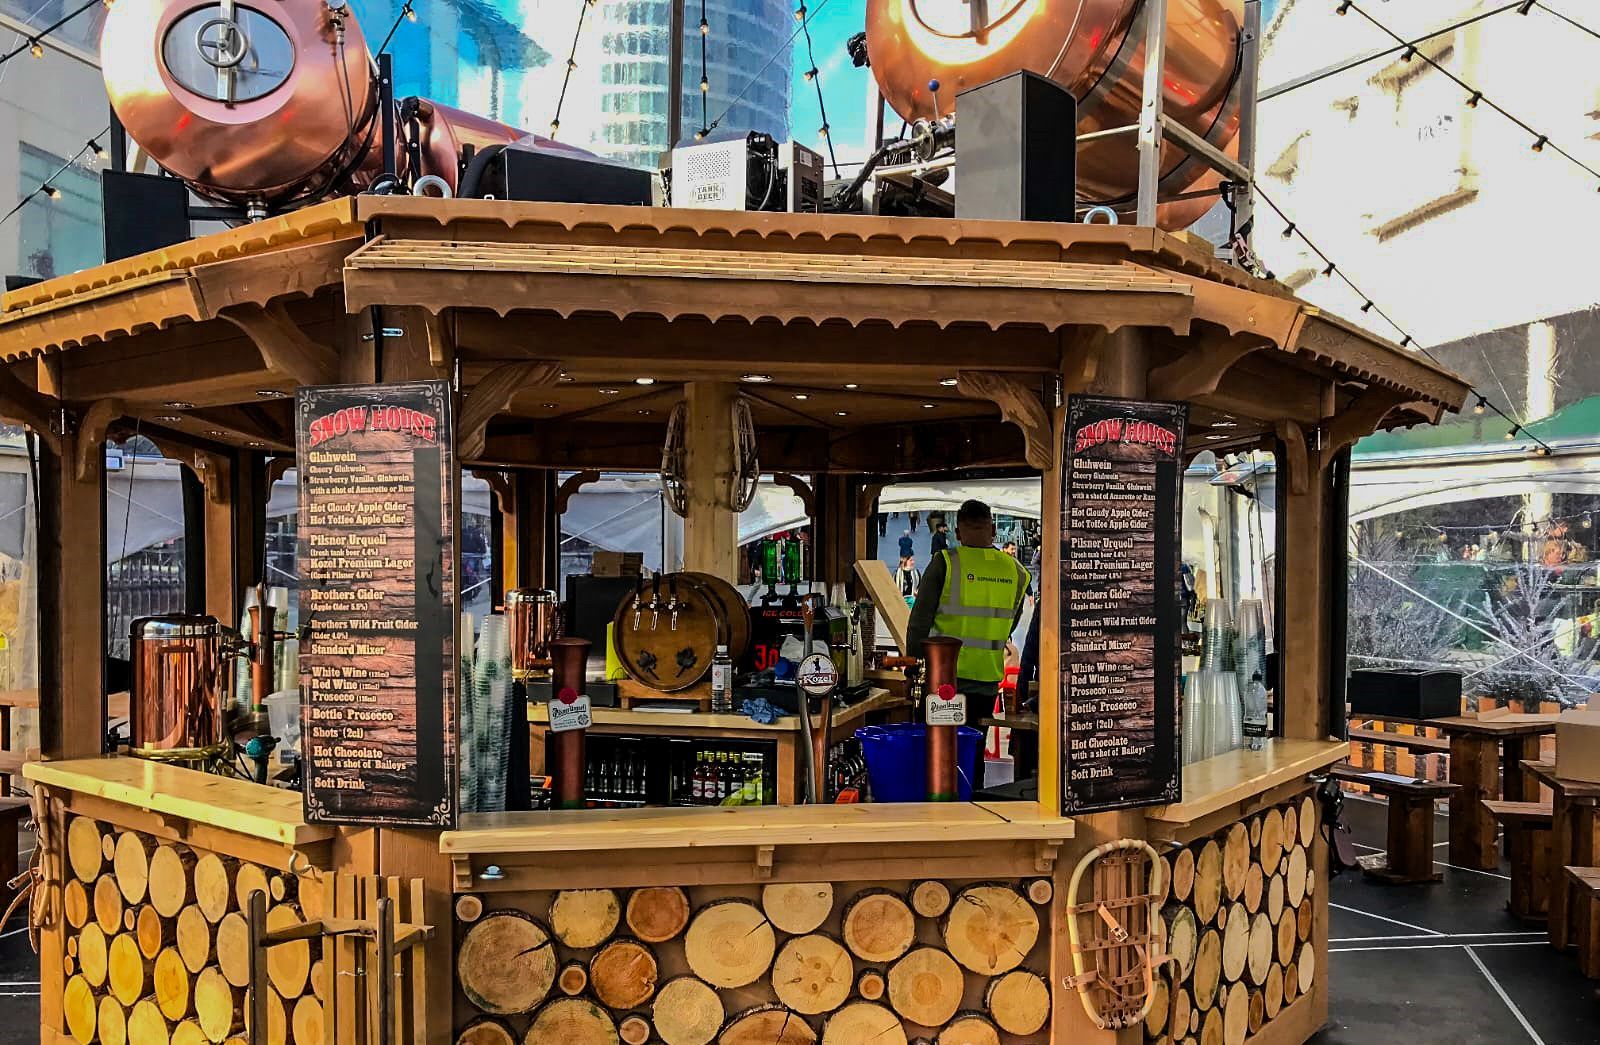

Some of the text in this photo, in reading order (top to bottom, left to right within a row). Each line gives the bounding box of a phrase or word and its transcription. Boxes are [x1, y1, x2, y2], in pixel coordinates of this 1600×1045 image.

[310, 404, 436, 447] SNOW HOUSE
[1075, 418, 1176, 457] SNOW HOUSE
[309, 452, 356, 463] Gluhwein
[310, 476, 349, 484] Strawberry
[310, 487, 325, 495] with
[310, 502, 407, 514] Hot Cloudy Apple Cider
[1071, 508, 1149, 518] Hot Cloudy Apple Cider
[310, 514, 406, 525] Hot Toffee Apple Cider
[1072, 519, 1148, 530] Hot Toffee Apple Cider
[310, 534, 386, 547] Pilsner Urquell
[1071, 537, 1133, 550] Pilsner Urquell
[310, 558, 413, 570] Kozel Premium Lager
[1071, 560, 1153, 571] Kozel Premium Lager
[311, 589, 385, 600] Brothers Cider
[1071, 589, 1131, 600] Brothers Cider
[311, 620, 419, 629] Brothers Wild Fruit Cider
[1071, 616, 1157, 627] Brothers Wild Fruit Cider
[311, 644, 385, 655] Standard Mixer
[1071, 640, 1131, 652] Standard Mixer
[312, 667, 340, 678] White
[342, 666, 367, 678] Wine
[1071, 663, 1094, 674] White
[1097, 662, 1117, 673] Wine
[312, 679, 331, 690] Red
[333, 678, 358, 689] Wine
[804, 674, 832, 684] Kozel
[1071, 675, 1087, 685] Red
[1089, 675, 1109, 684] Wine
[312, 691, 354, 702] Prosecco
[1071, 686, 1106, 697] Prosecco
[1071, 701, 1137, 714] Bottle Prosecco
[313, 708, 394, 721] Bottle Prosecco
[1071, 721, 1092, 731] Shots
[313, 727, 338, 738] Shots
[1071, 736, 1128, 750] Hot Chocolate
[314, 746, 383, 758] Hot Chocolate
[1071, 751, 1087, 761] with
[1096, 749, 1110, 758] shot
[1112, 748, 1119, 757] of
[1121, 746, 1146, 756] Baileys
[314, 759, 332, 768] with
[343, 759, 361, 768] shot
[363, 759, 371, 768] of
[375, 760, 406, 771] Baileys
[1071, 767, 1114, 780] Soft Drink
[314, 777, 365, 790] Soft Drink
